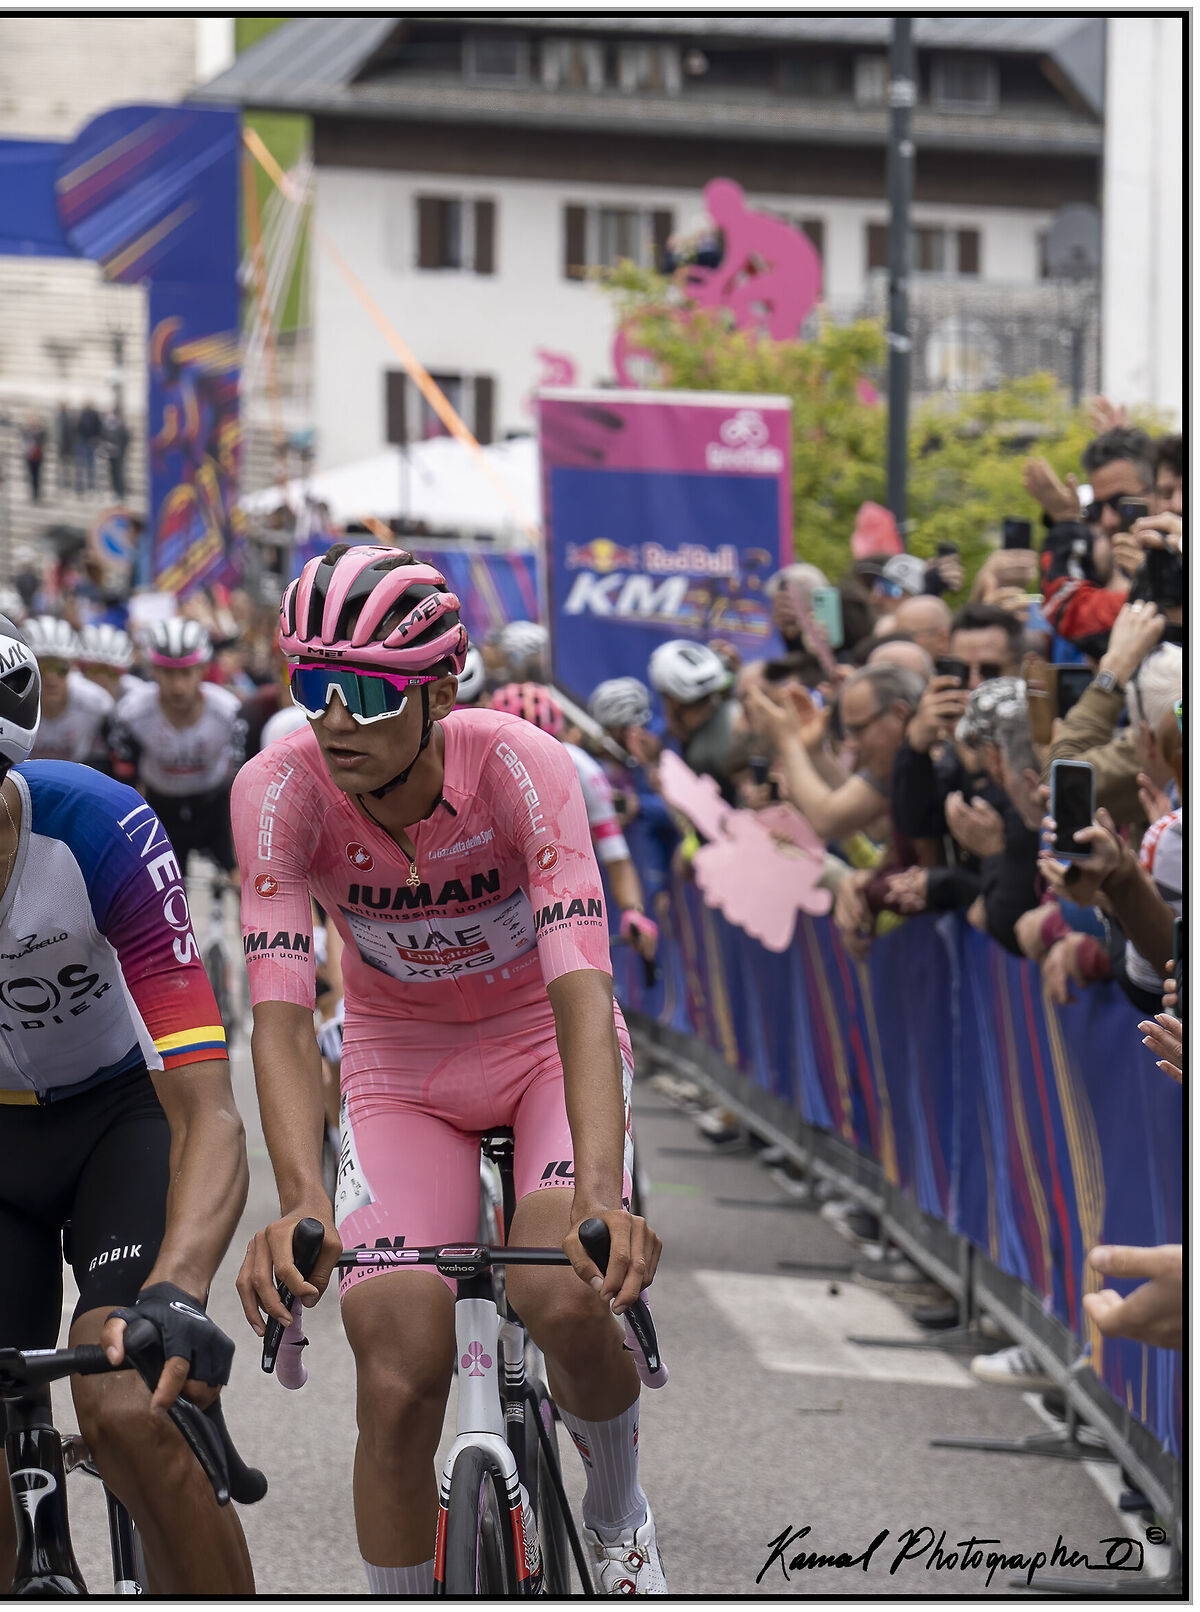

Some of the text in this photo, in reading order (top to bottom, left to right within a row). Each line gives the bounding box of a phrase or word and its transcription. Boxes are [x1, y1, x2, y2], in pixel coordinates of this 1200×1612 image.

[564, 572, 689, 617] KM
[398, 594, 441, 637] MET
[308, 647, 347, 658] MET
[117, 803, 200, 964] INEOS
[348, 868, 501, 910] IUMAN
[456, 894, 501, 914] uomo
[576, 919, 603, 928] uomo
[387, 925, 486, 950] UAE
[280, 952, 309, 962] uomo
[88, 1244, 143, 1272] GOBIK
[439, 1264, 475, 1272] wahoo
